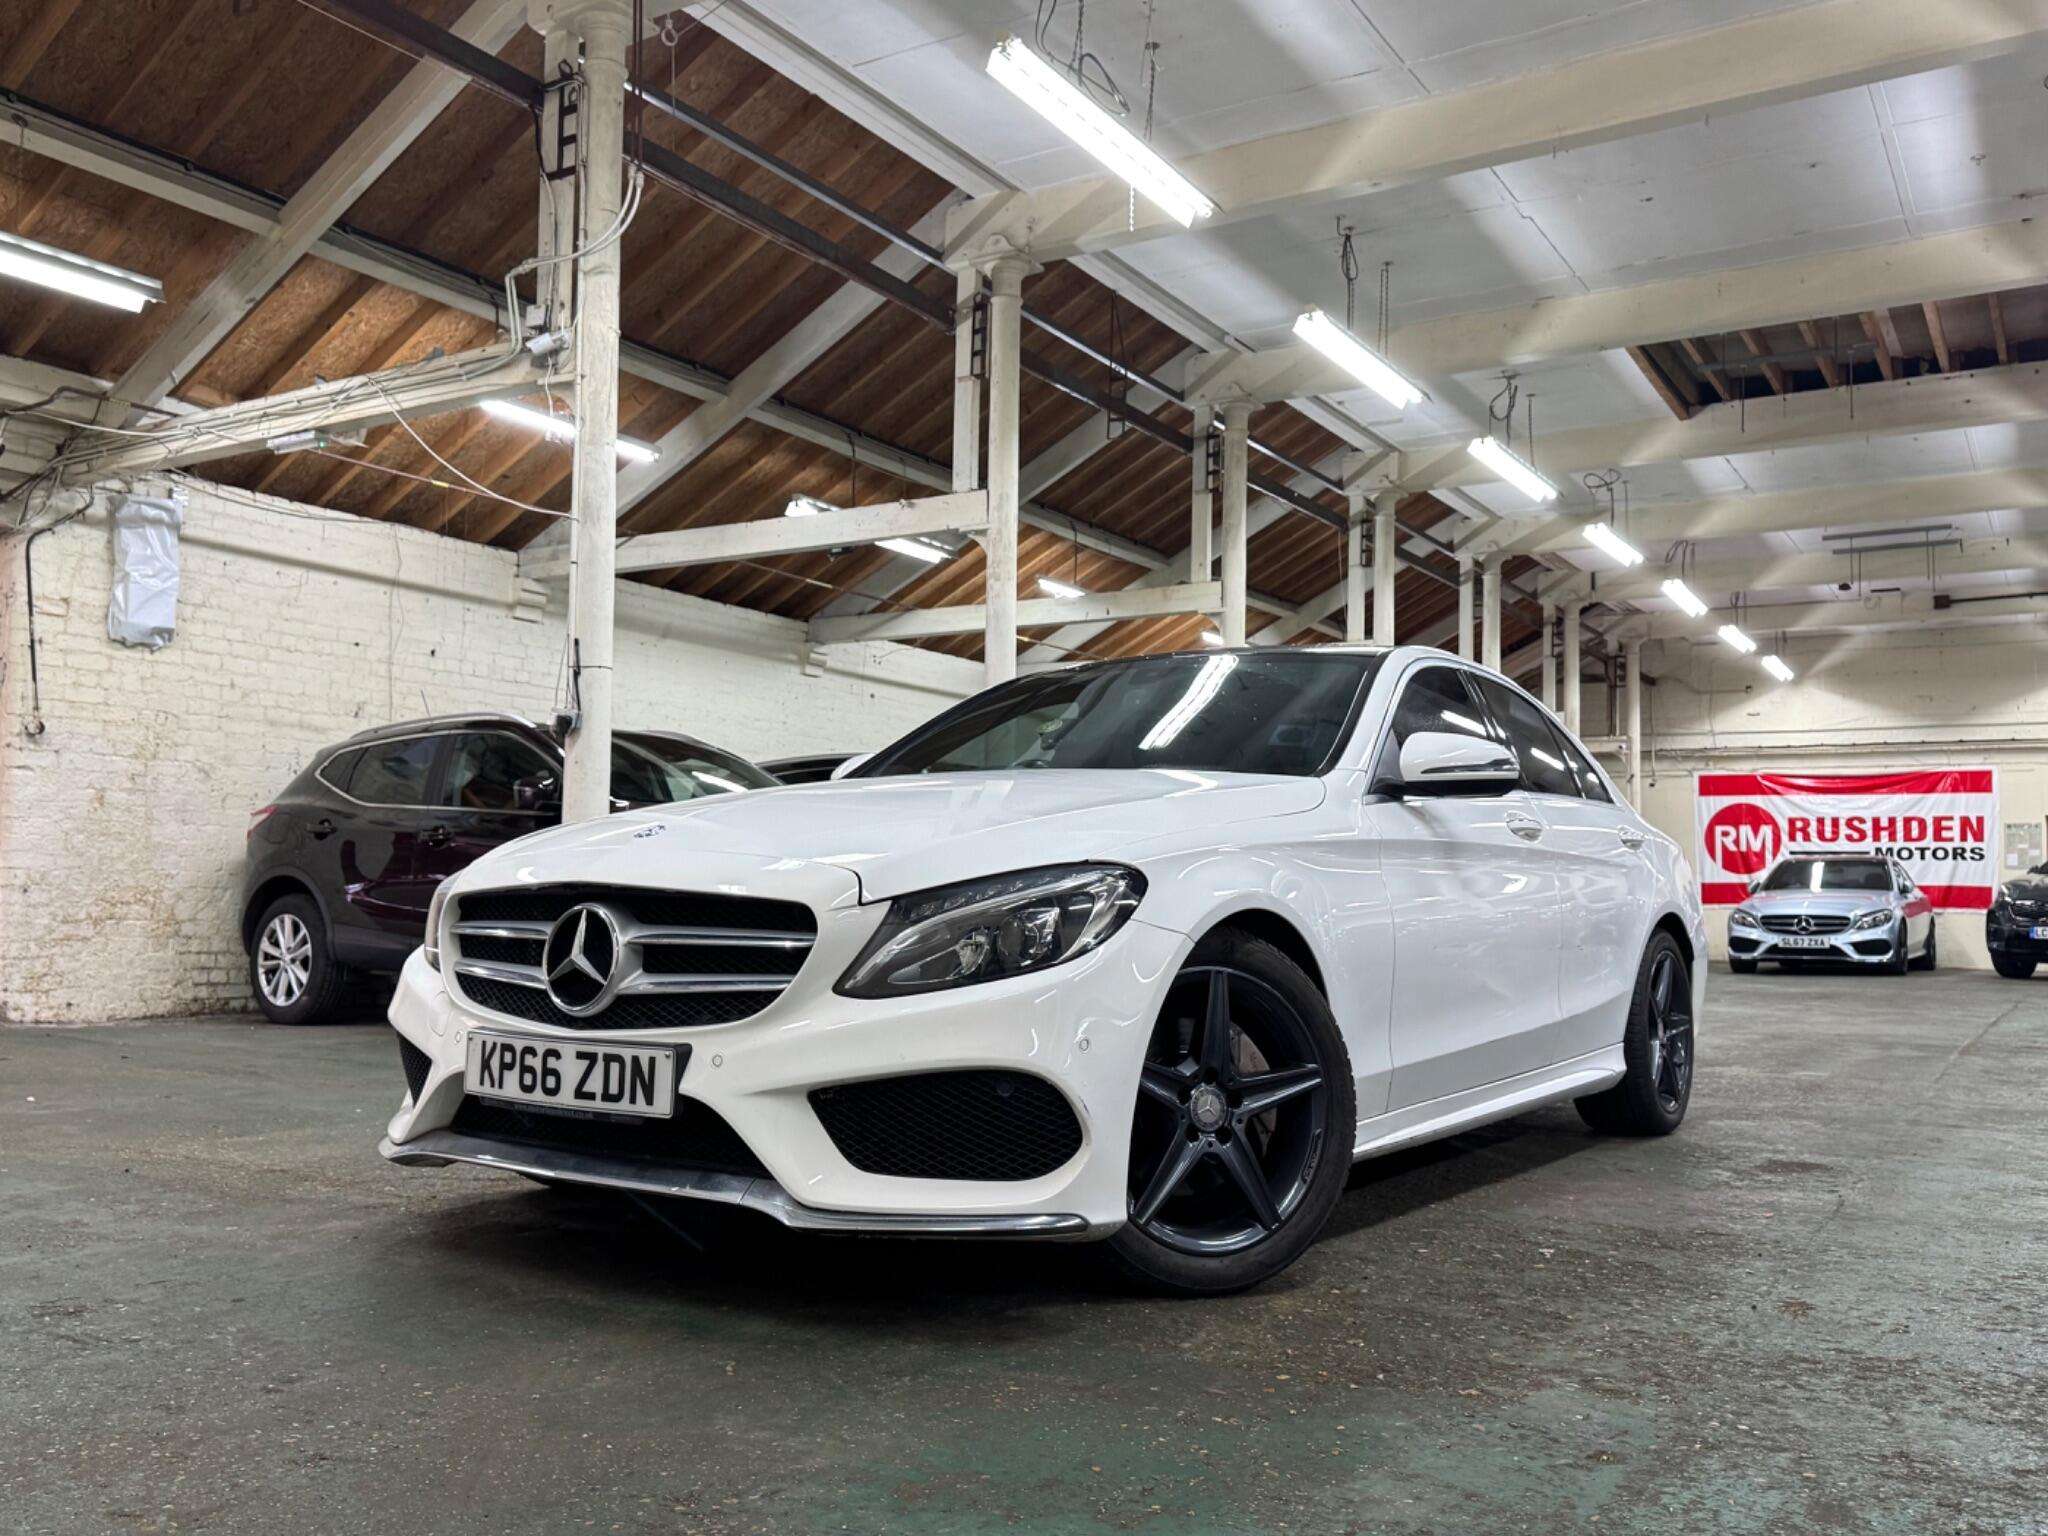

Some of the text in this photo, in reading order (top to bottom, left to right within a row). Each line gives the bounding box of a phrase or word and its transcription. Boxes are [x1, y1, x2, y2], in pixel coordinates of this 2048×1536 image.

[1787, 816, 1984, 842] RUSHDEN
[1715, 825, 1772, 866] RM
[1874, 847, 1985, 861] MOTORS
[1807, 937, 1825, 947] ZXA
[479, 1040, 656, 1106] KP66 ZDN
